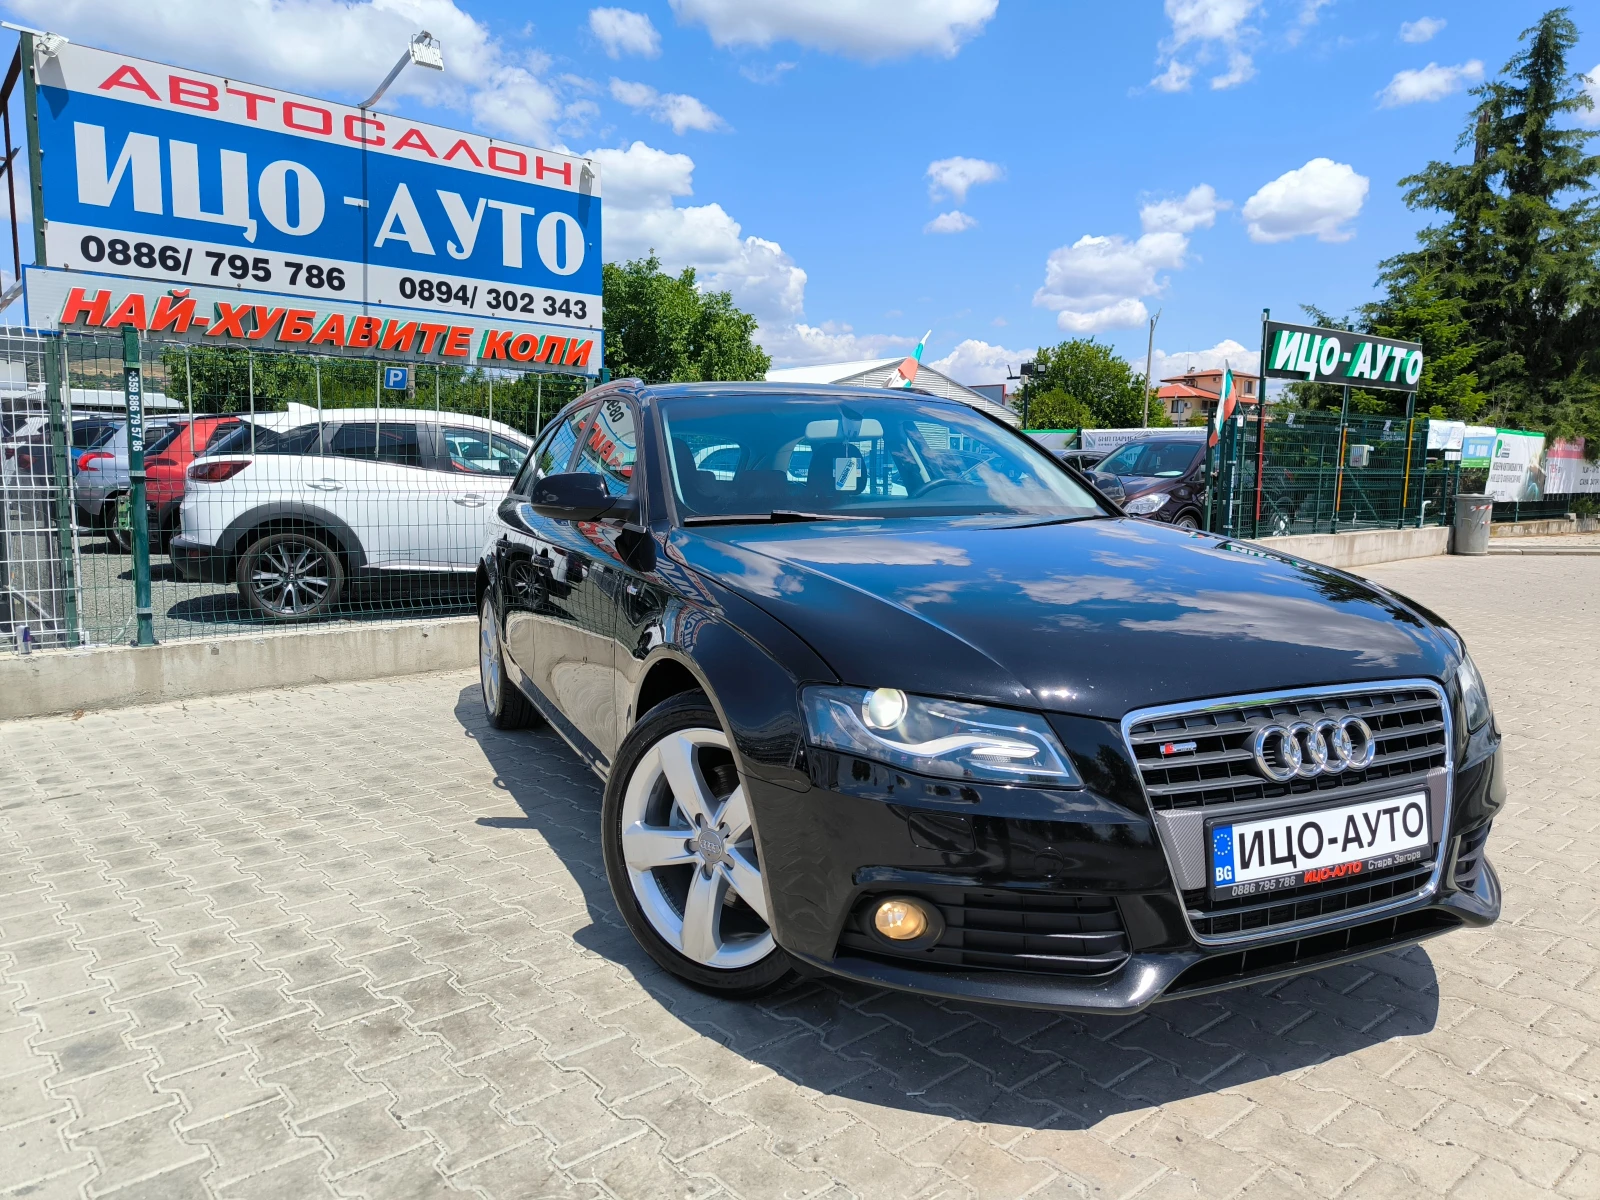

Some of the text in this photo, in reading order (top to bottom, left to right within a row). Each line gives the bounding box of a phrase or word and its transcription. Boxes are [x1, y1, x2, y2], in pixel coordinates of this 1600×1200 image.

[98, 64, 572, 186] АВТОСАЛОН
[80, 235, 587, 320] 0886/ 795 786 0894/ 302 343
[59, 287, 593, 367] НАЙ-ХУБАВИТЕ КОЛИ
[389, 369, 403, 386] P
[1269, 330, 1424, 385] ИЦО-АУТО
[128, 371, 143, 452] +359 886 79 57 86
[1238, 801, 1425, 869] ИЦО-АУТО
[1367, 851, 1421, 871] Стара Загора
[1215, 866, 1233, 882] BG
[1231, 875, 1296, 897] 0886 795 786
[1303, 861, 1363, 884] ИЦО-АУТО
